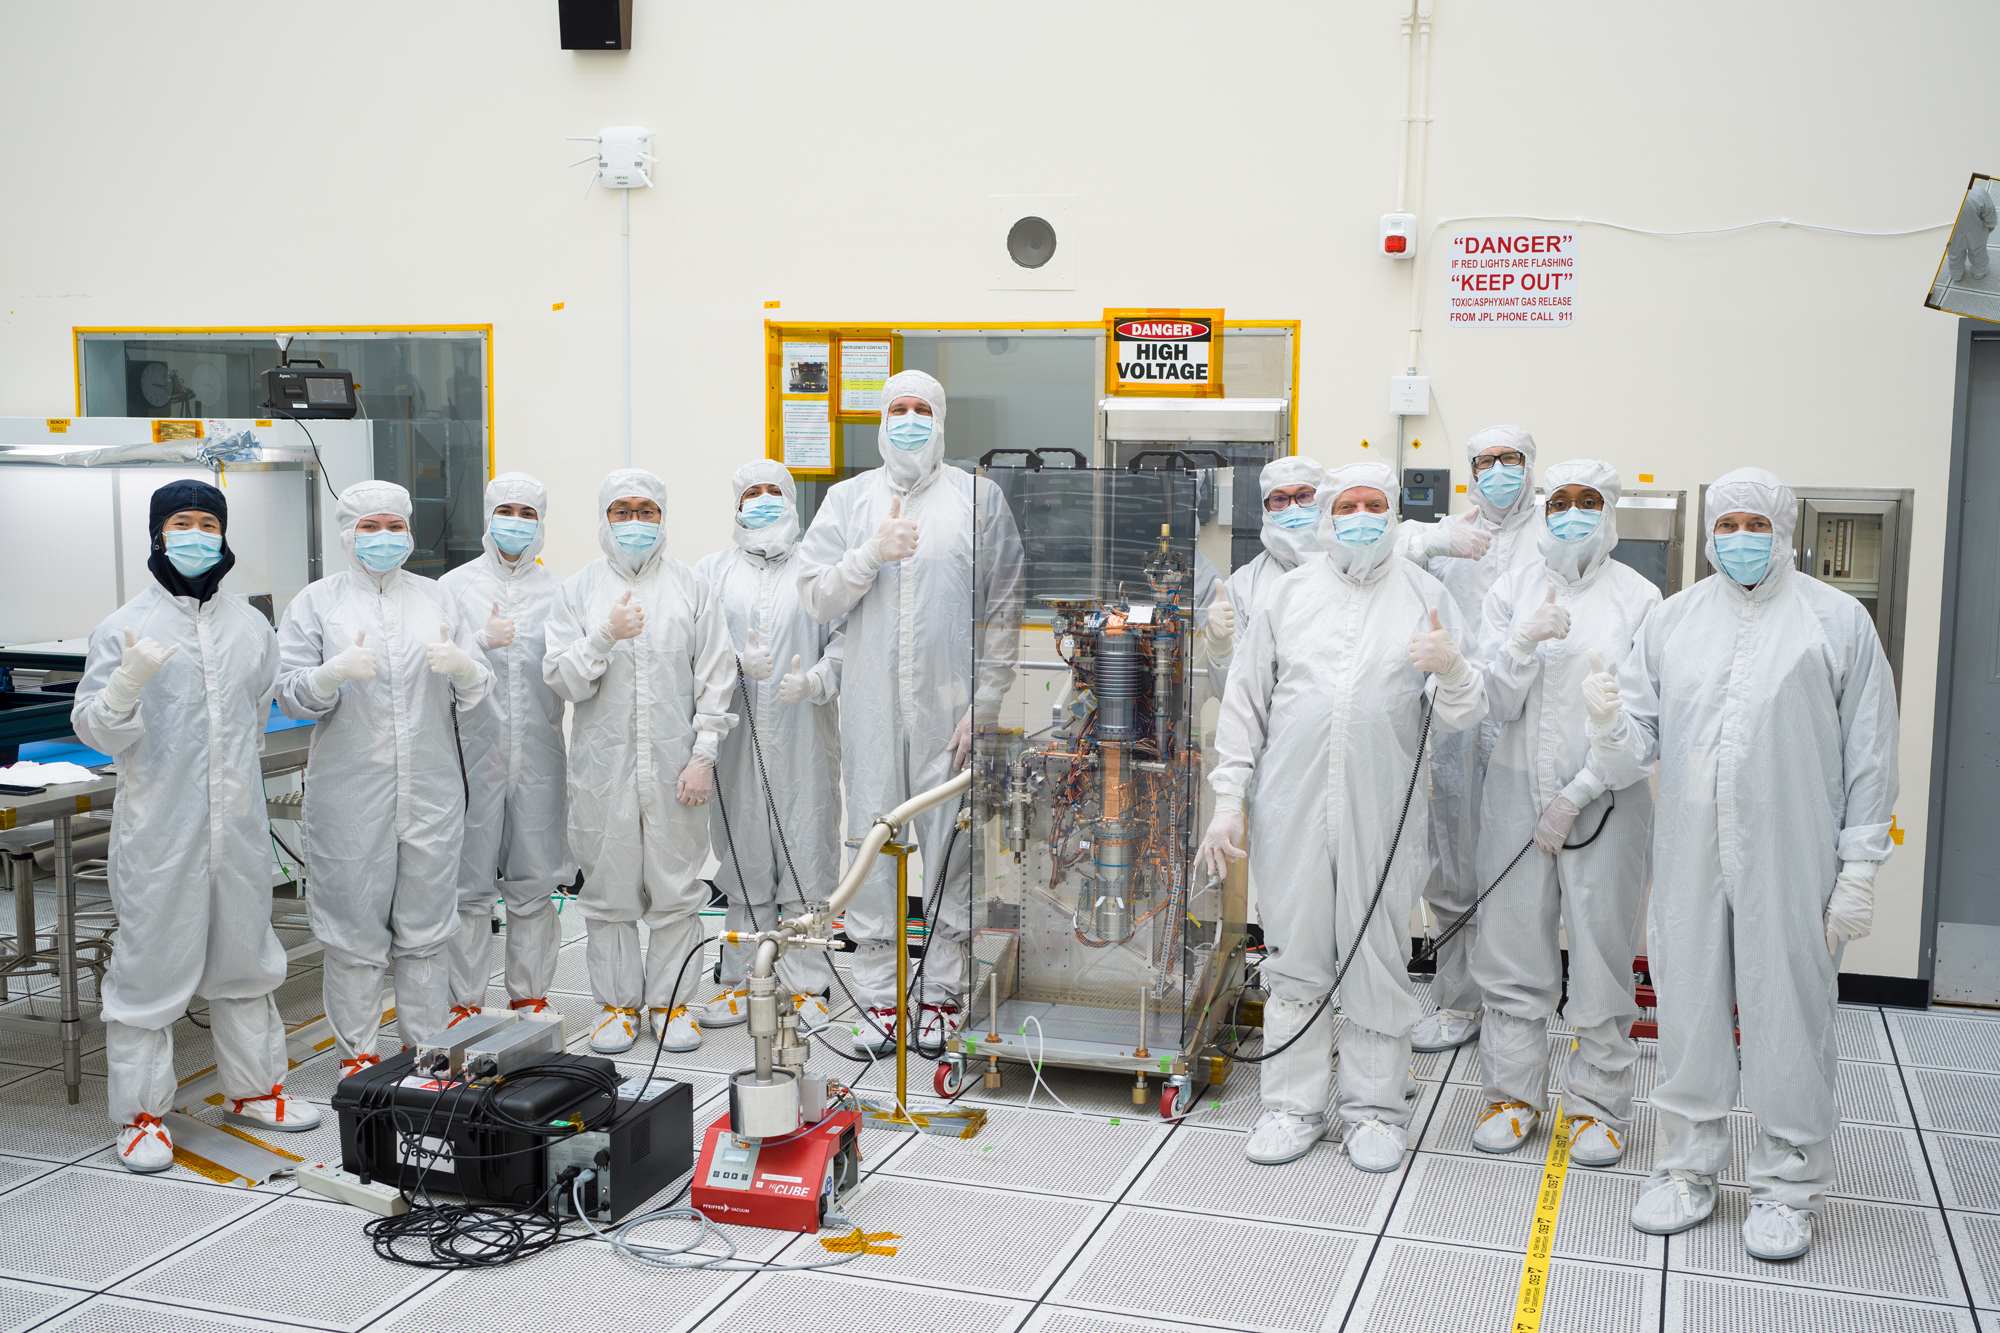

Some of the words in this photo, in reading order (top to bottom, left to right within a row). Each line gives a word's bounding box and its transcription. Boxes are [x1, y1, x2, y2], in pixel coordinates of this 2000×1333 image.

[1454, 236, 1572, 254] “DANGER”
[1452, 260, 1459, 268] IF
[1461, 260, 1478, 268] RED
[1481, 259, 1510, 268] LIGHTS
[1512, 259, 1529, 267] ARE
[1531, 258, 1573, 267] FLASHING
[1452, 274, 1514, 291] “KEEP
[1521, 274, 1572, 290] OUT”
[1452, 298, 1519, 307] TOXIC/ASPHYXIANT
[1521, 297, 1536, 306] GAS
[1539, 297, 1572, 306] RELEASE
[1450, 313, 1475, 321] FROM
[1478, 313, 1494, 321] JPL
[1497, 312, 1528, 321] PHONE
[1531, 312, 1553, 321] CALL
[1559, 312, 1572, 321] 911
[1132, 324, 1192, 336] DANGER
[1137, 344, 1187, 360] HIGH
[1116, 363, 1208, 380] VOLTAGE
[1557, 1140, 1566, 1148] ESD
[442, 1149, 450, 1163] 4
[1548, 1180, 1558, 1189] ESD
[1539, 1224, 1549, 1234] ESD
[1529, 1275, 1540, 1285] ESD
